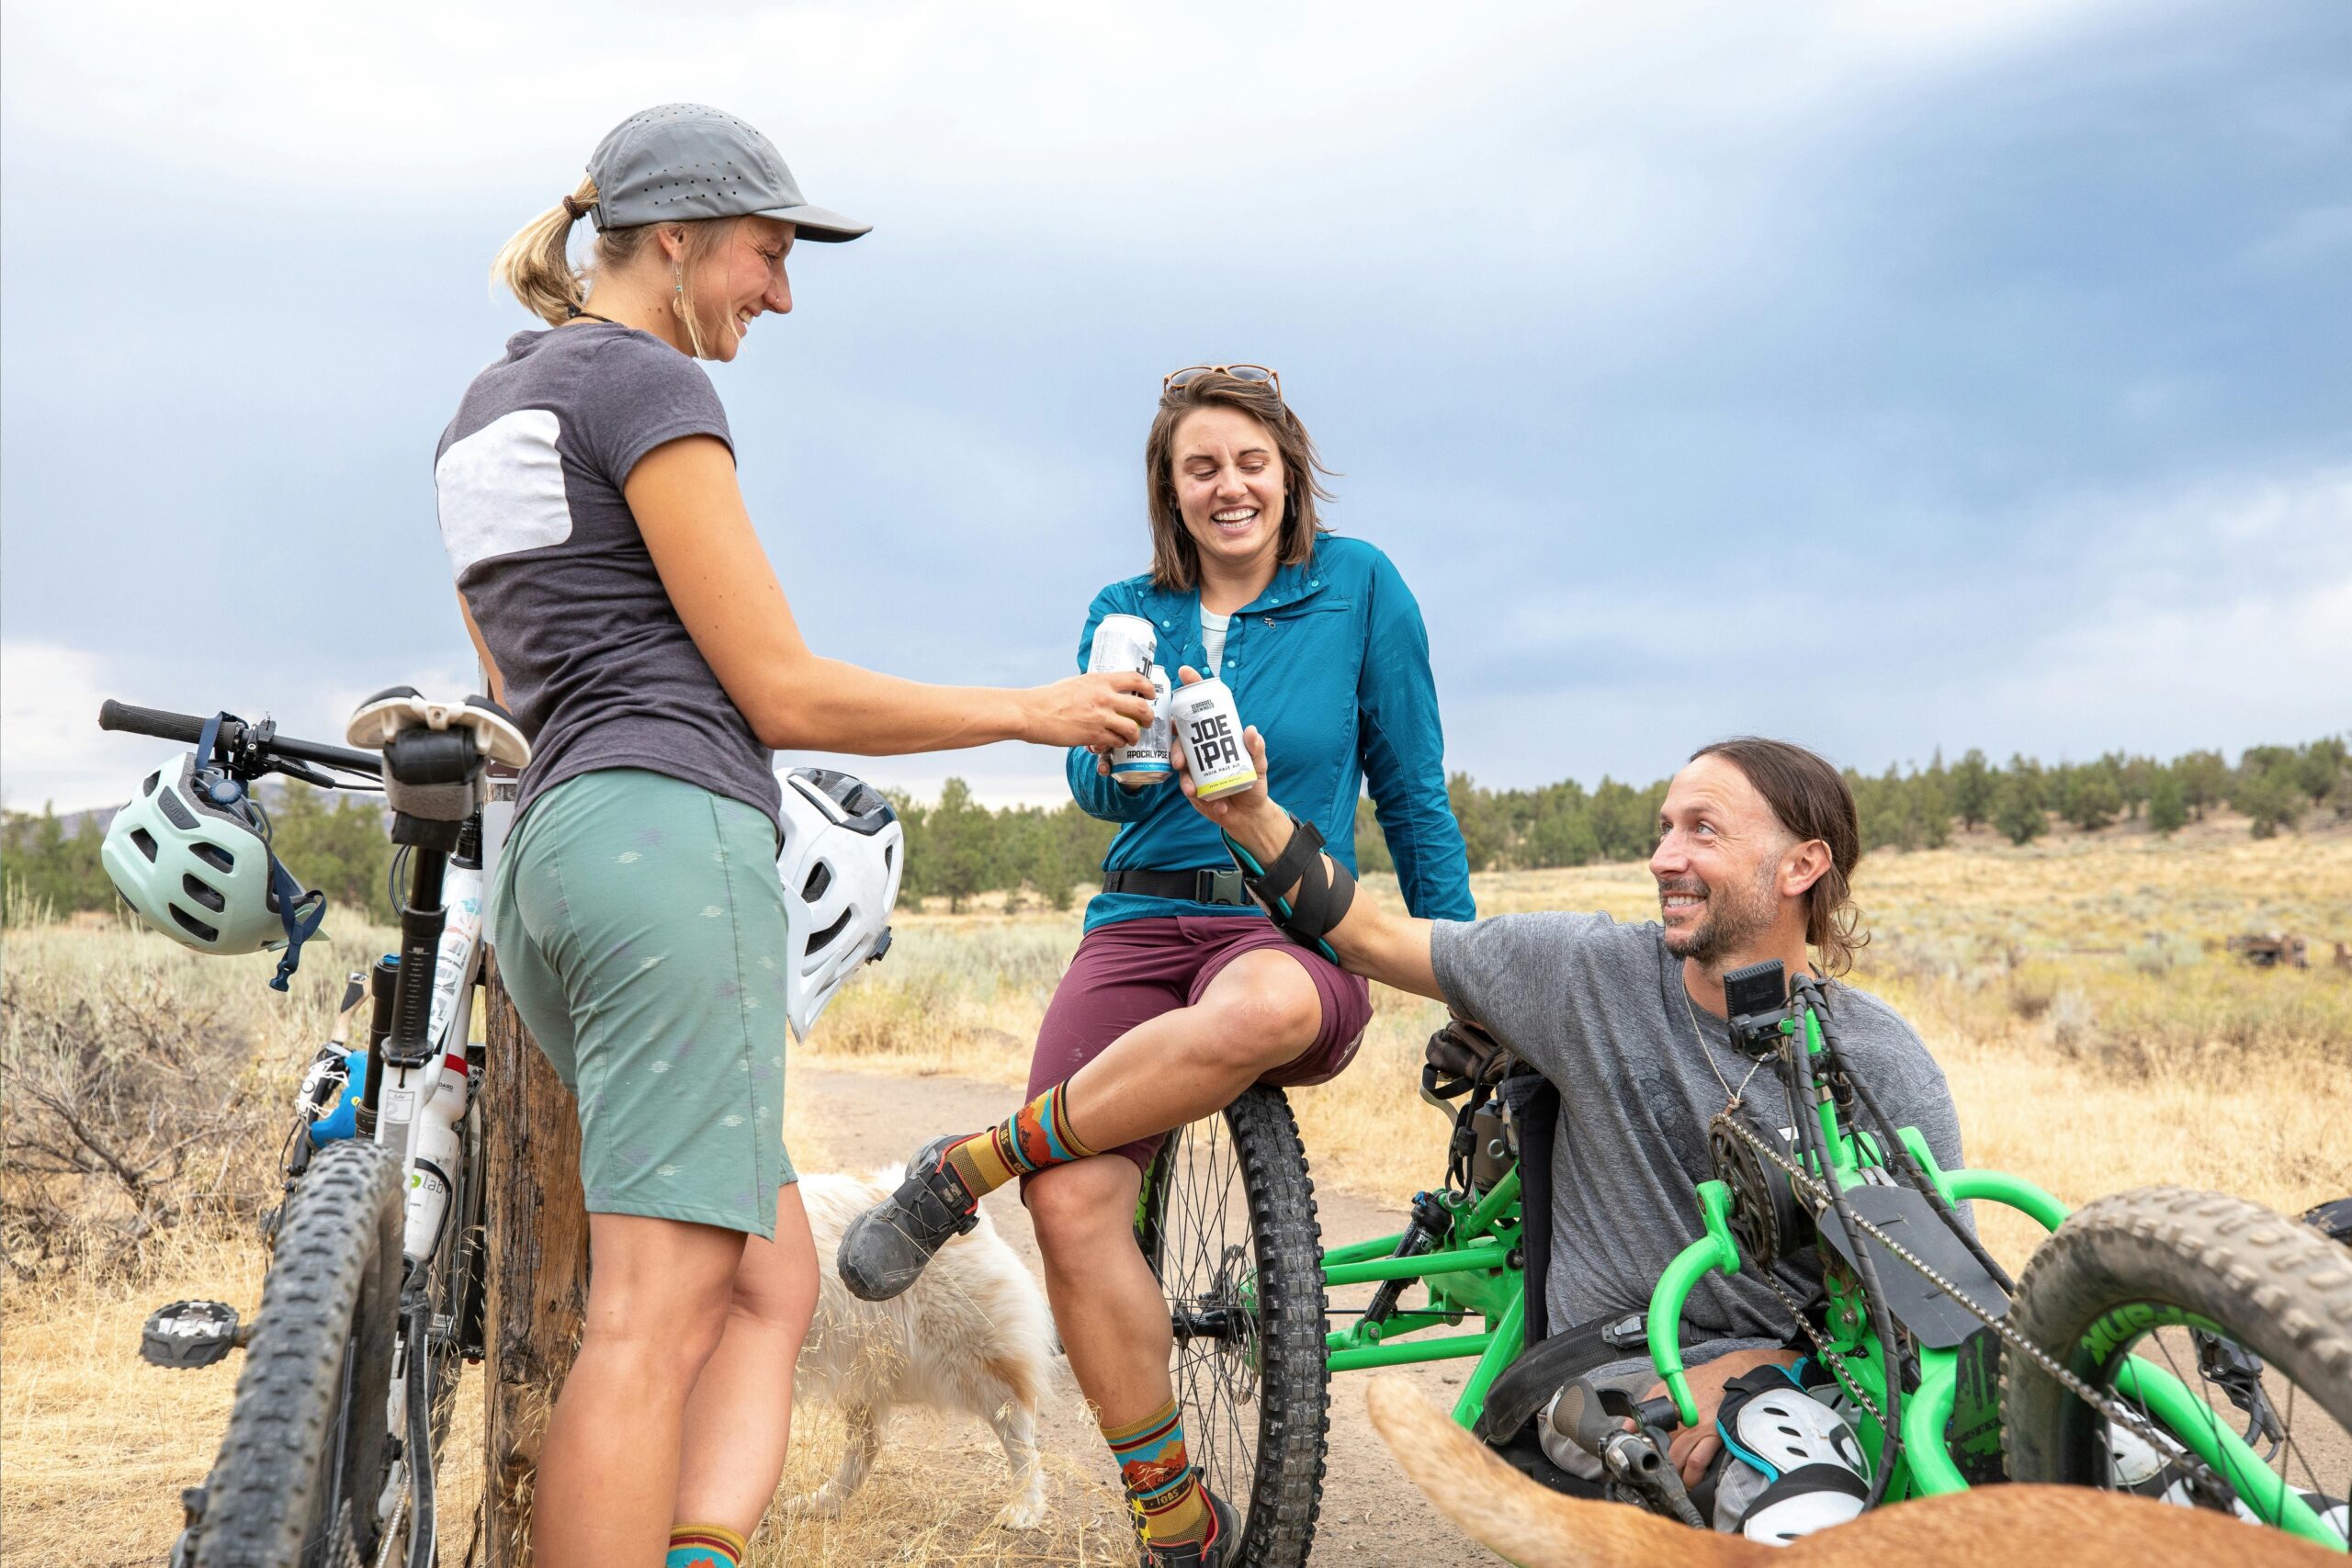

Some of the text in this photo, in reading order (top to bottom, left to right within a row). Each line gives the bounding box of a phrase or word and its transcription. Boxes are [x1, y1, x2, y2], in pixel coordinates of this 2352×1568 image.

[1191, 714, 1232, 745] JOE
[1126, 750, 1168, 760] APOCALYPSE
[1193, 736, 1239, 772] IPA
